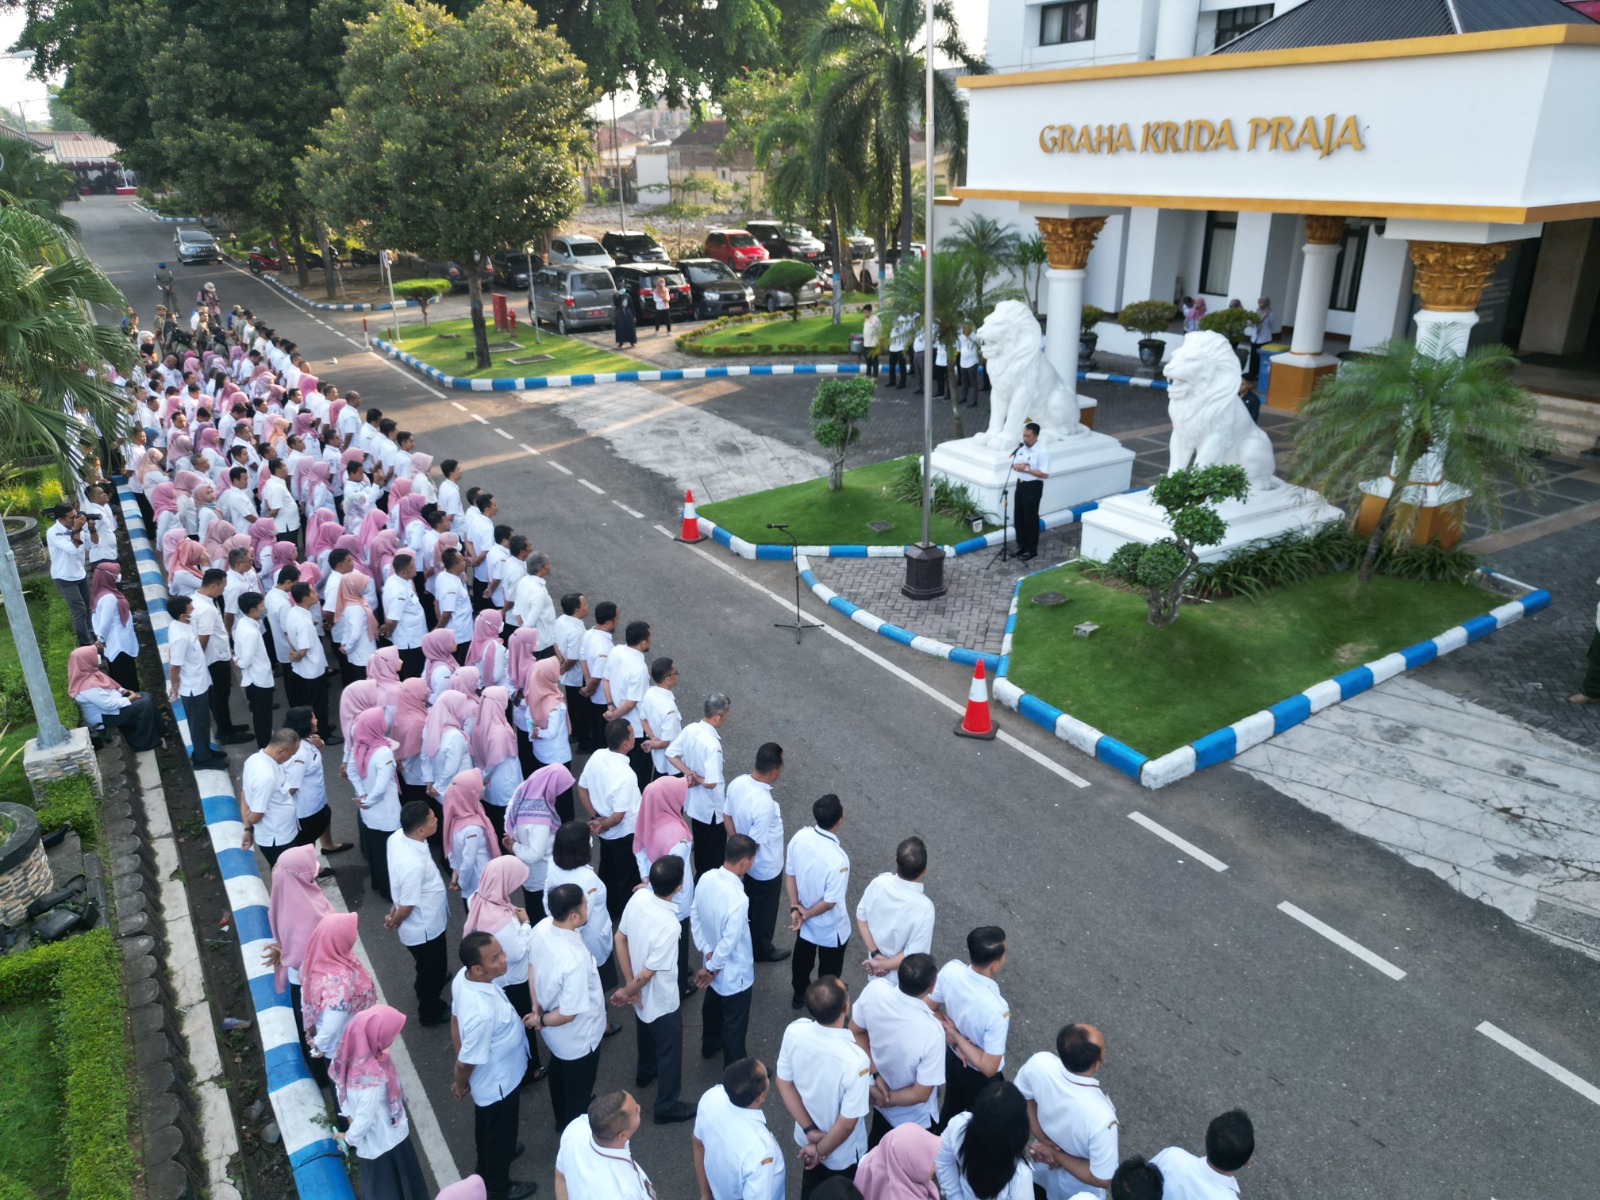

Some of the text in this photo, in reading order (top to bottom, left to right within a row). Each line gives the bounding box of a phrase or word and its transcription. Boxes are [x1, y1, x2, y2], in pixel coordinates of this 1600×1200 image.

[1039, 113, 1366, 160] GRAHA KRIDA PRAJA
